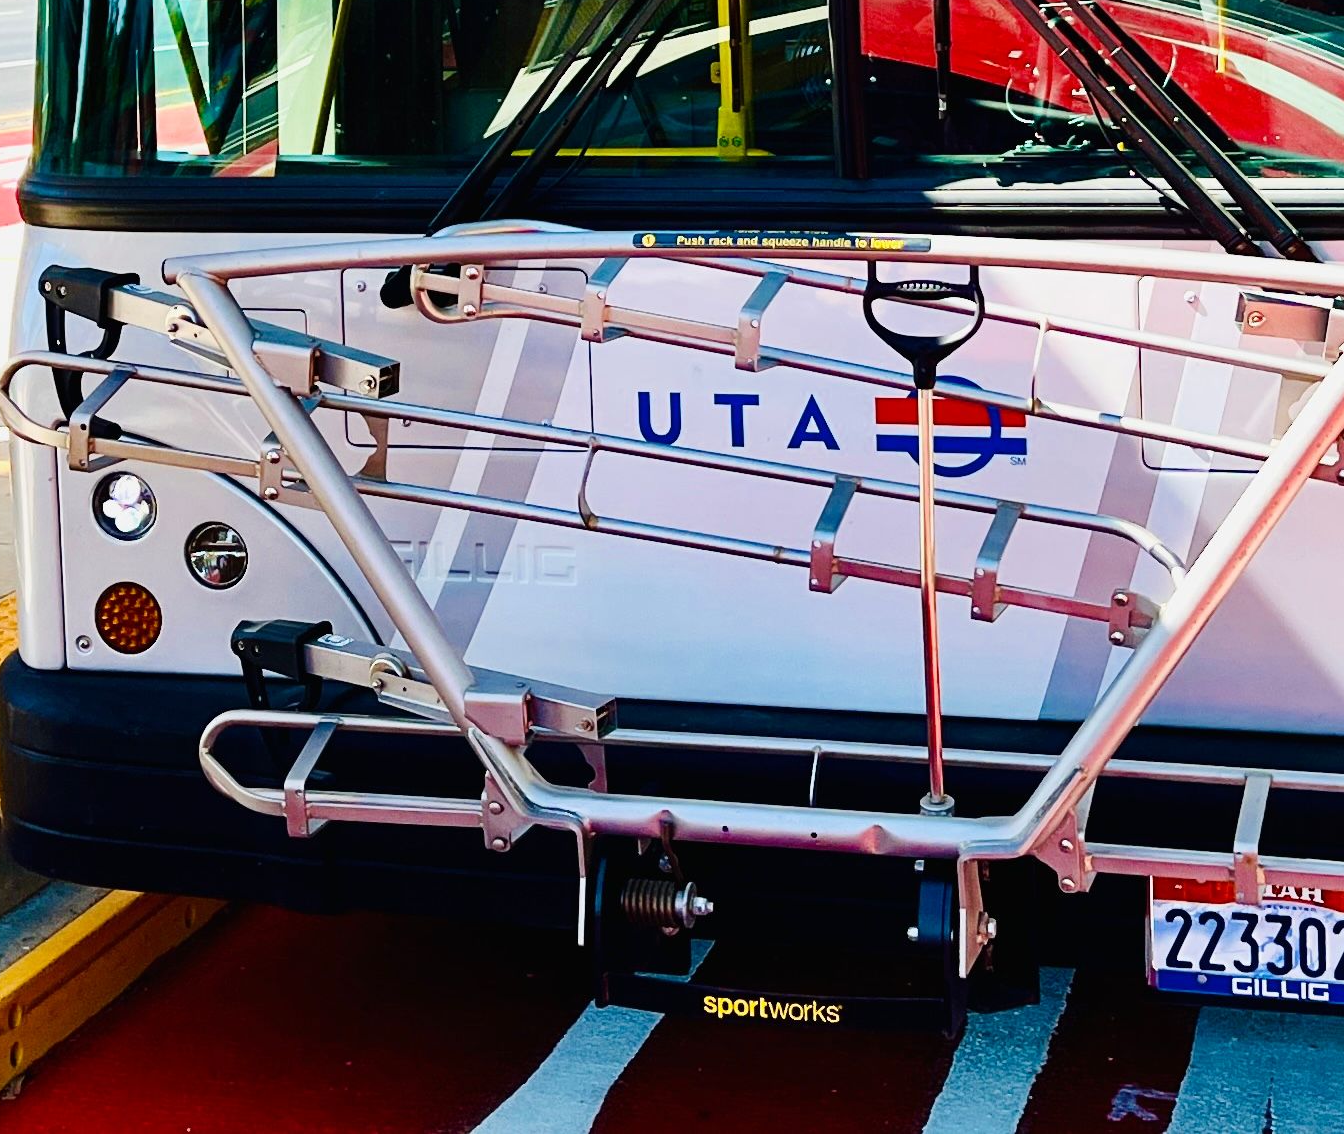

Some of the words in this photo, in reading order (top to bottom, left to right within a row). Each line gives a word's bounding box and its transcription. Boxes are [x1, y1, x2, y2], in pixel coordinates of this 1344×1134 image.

[676, 235, 705, 246] Push
[708, 235, 734, 246] rack
[736, 235, 759, 246] and
[761, 236, 809, 249] squeeze
[812, 237, 852, 248] handle
[855, 239, 868, 249] to
[870, 238, 905, 250] lower
[637, 390, 842, 451] UTA
[1231, 977, 1330, 1002] GILLIG
[702, 994, 842, 1024] sportworks
